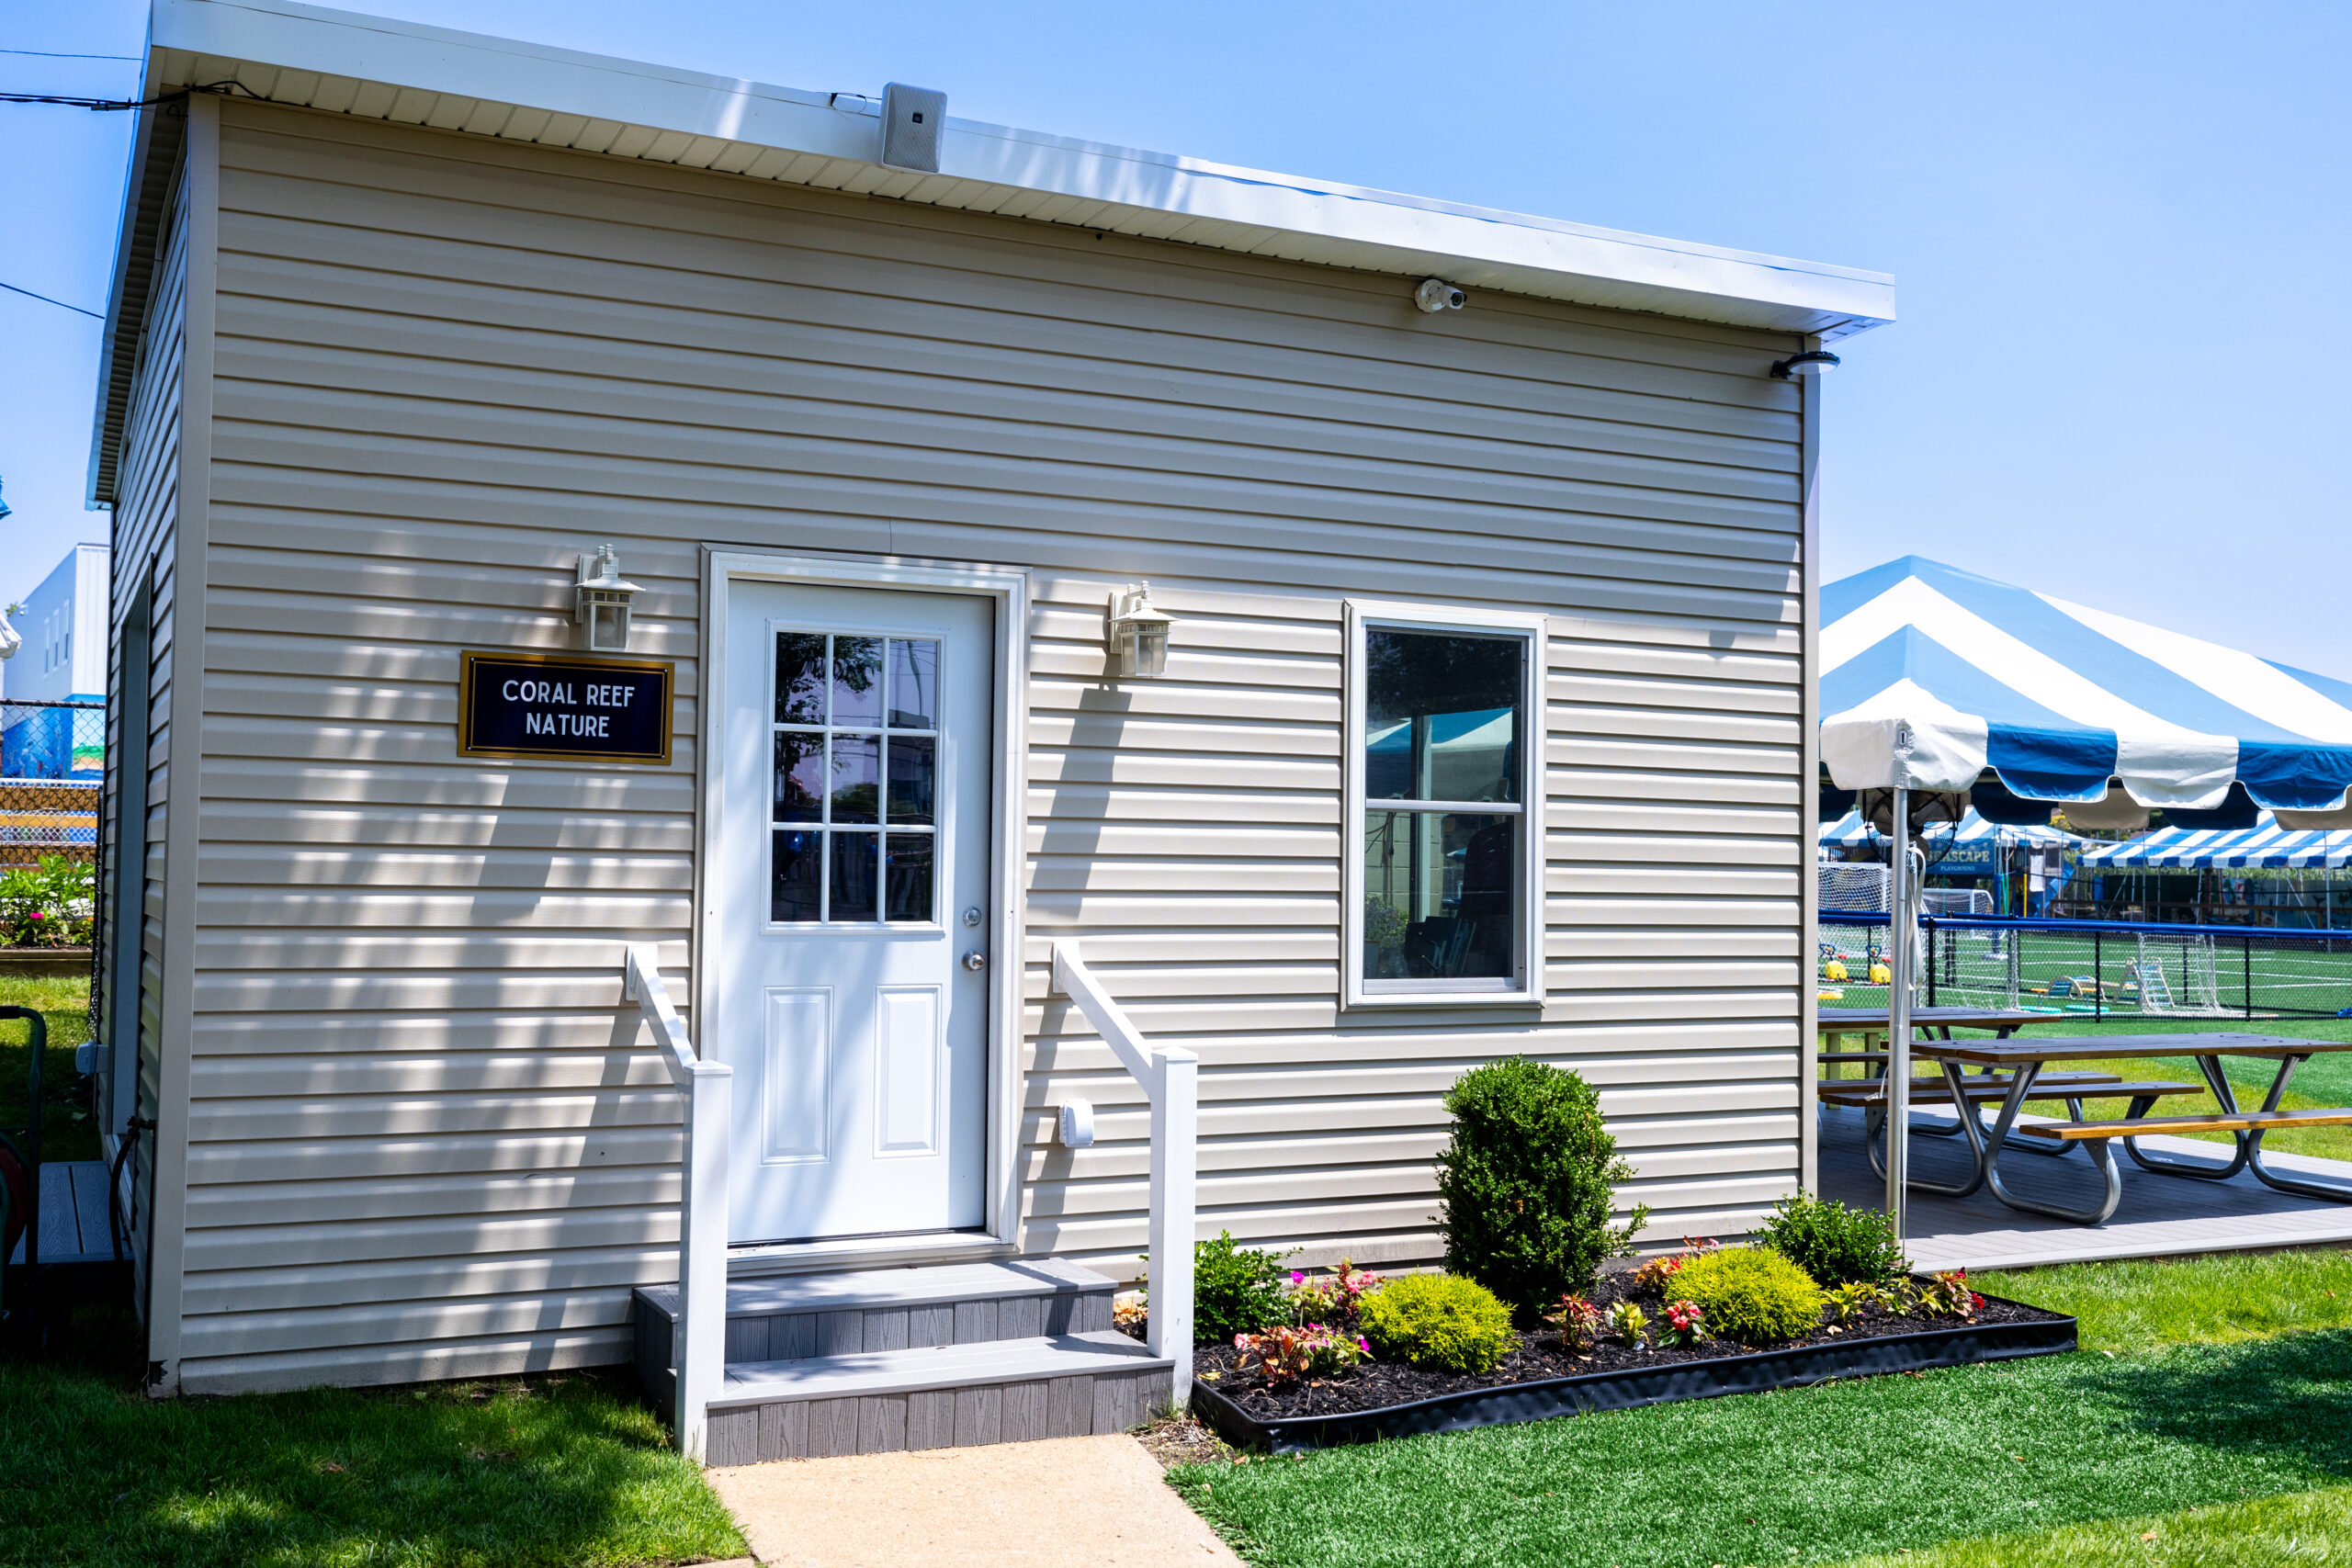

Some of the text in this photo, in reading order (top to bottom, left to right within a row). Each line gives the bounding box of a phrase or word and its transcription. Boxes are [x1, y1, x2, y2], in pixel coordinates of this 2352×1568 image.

[503, 680, 635, 707] CORAL REEF
[526, 712, 610, 738] NATURE
